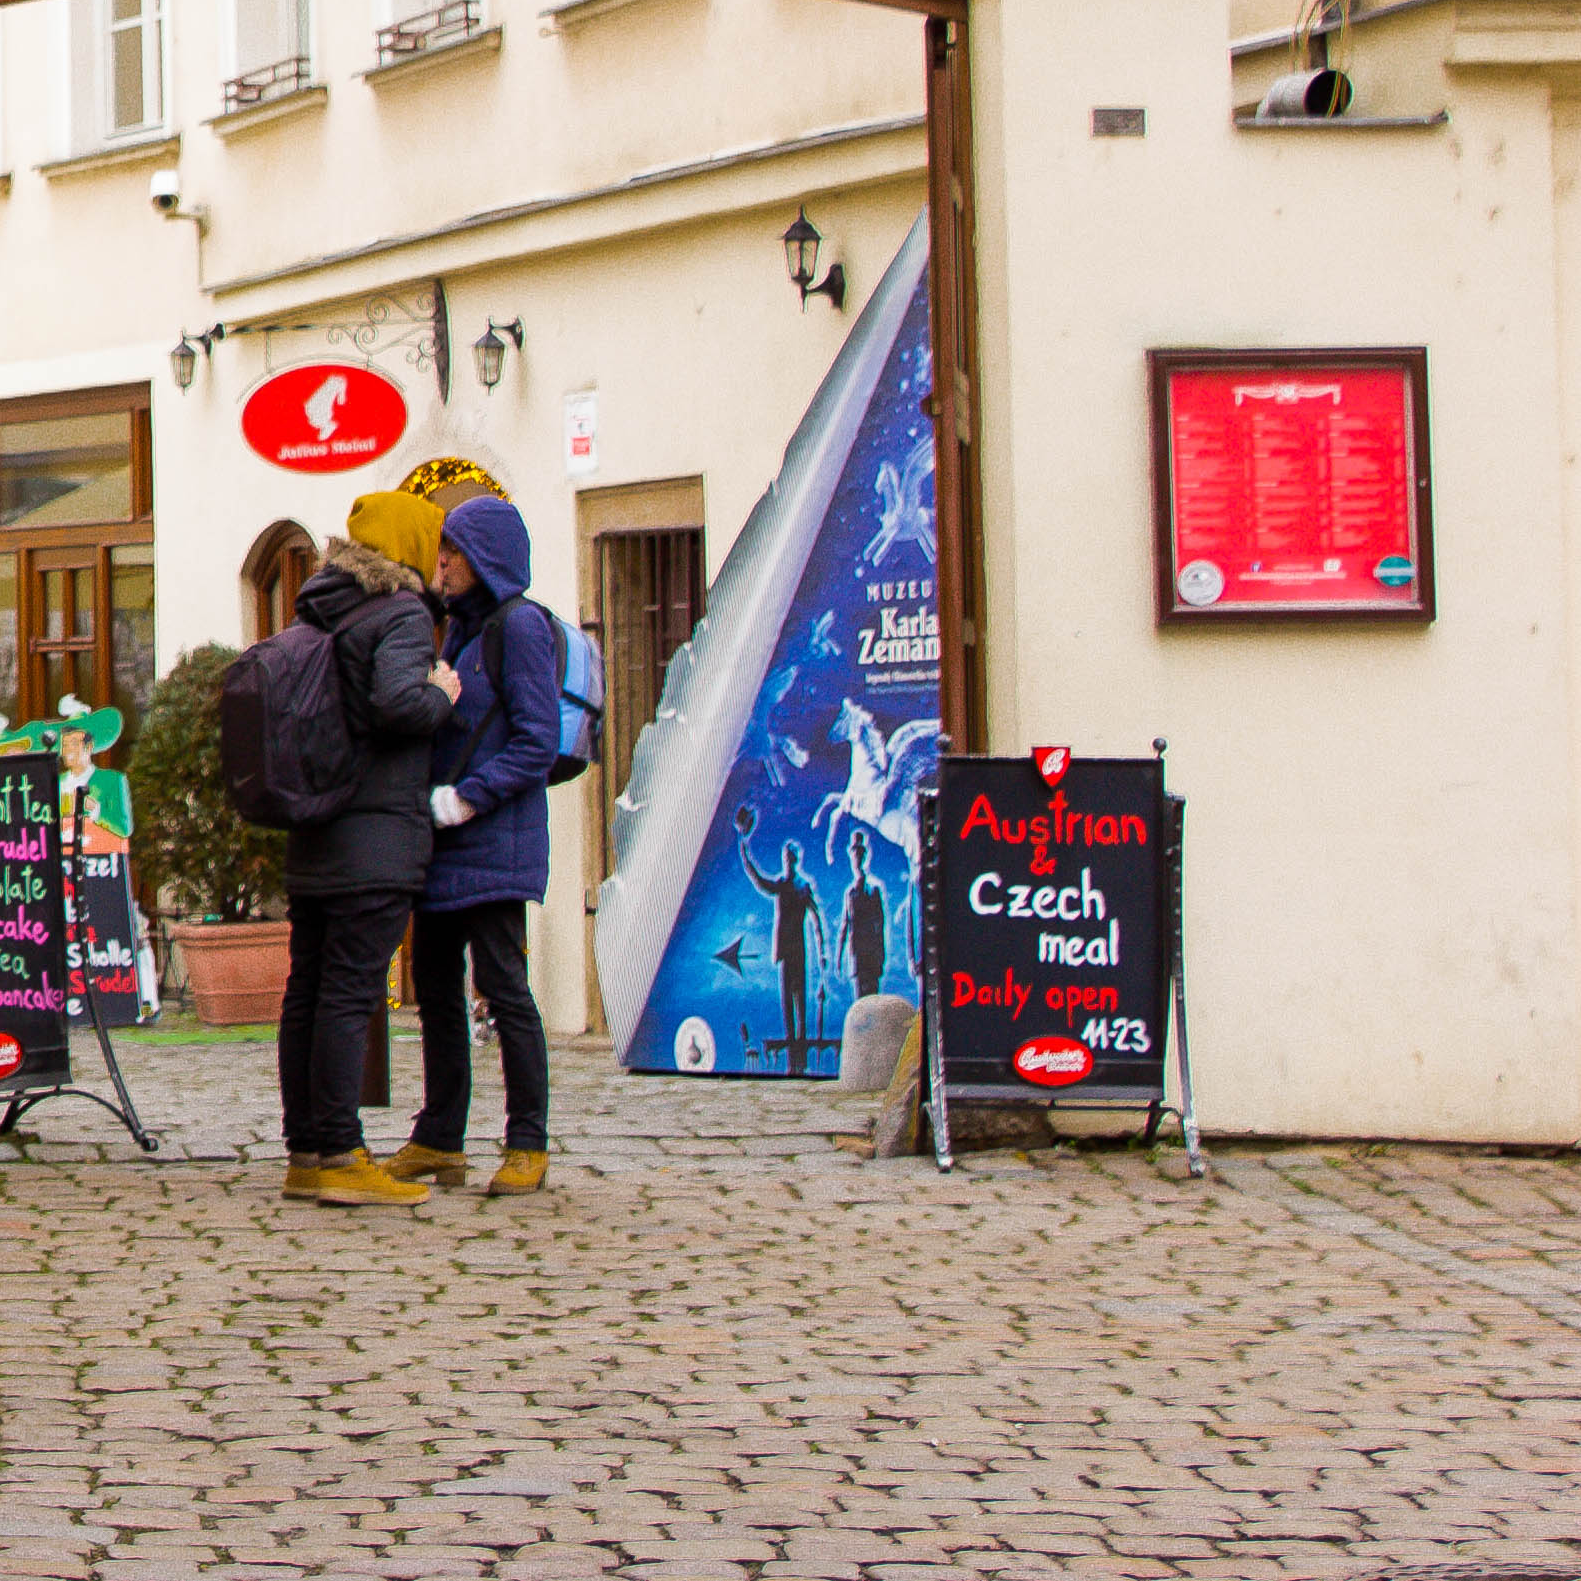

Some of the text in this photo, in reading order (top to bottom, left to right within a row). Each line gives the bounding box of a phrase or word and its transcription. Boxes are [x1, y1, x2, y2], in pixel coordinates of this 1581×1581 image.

[866, 579, 934, 602] MUZEU
[880, 604, 940, 639] Karla
[17, 772, 55, 824] tea
[959, 788, 1149, 846] Austrian
[1029, 842, 1057, 876] &
[968, 866, 1108, 922] Czech
[1037, 917, 1121, 966] meal
[950, 966, 1120, 1029] Daily open
[1080, 1017, 1153, 1054] 11-23
